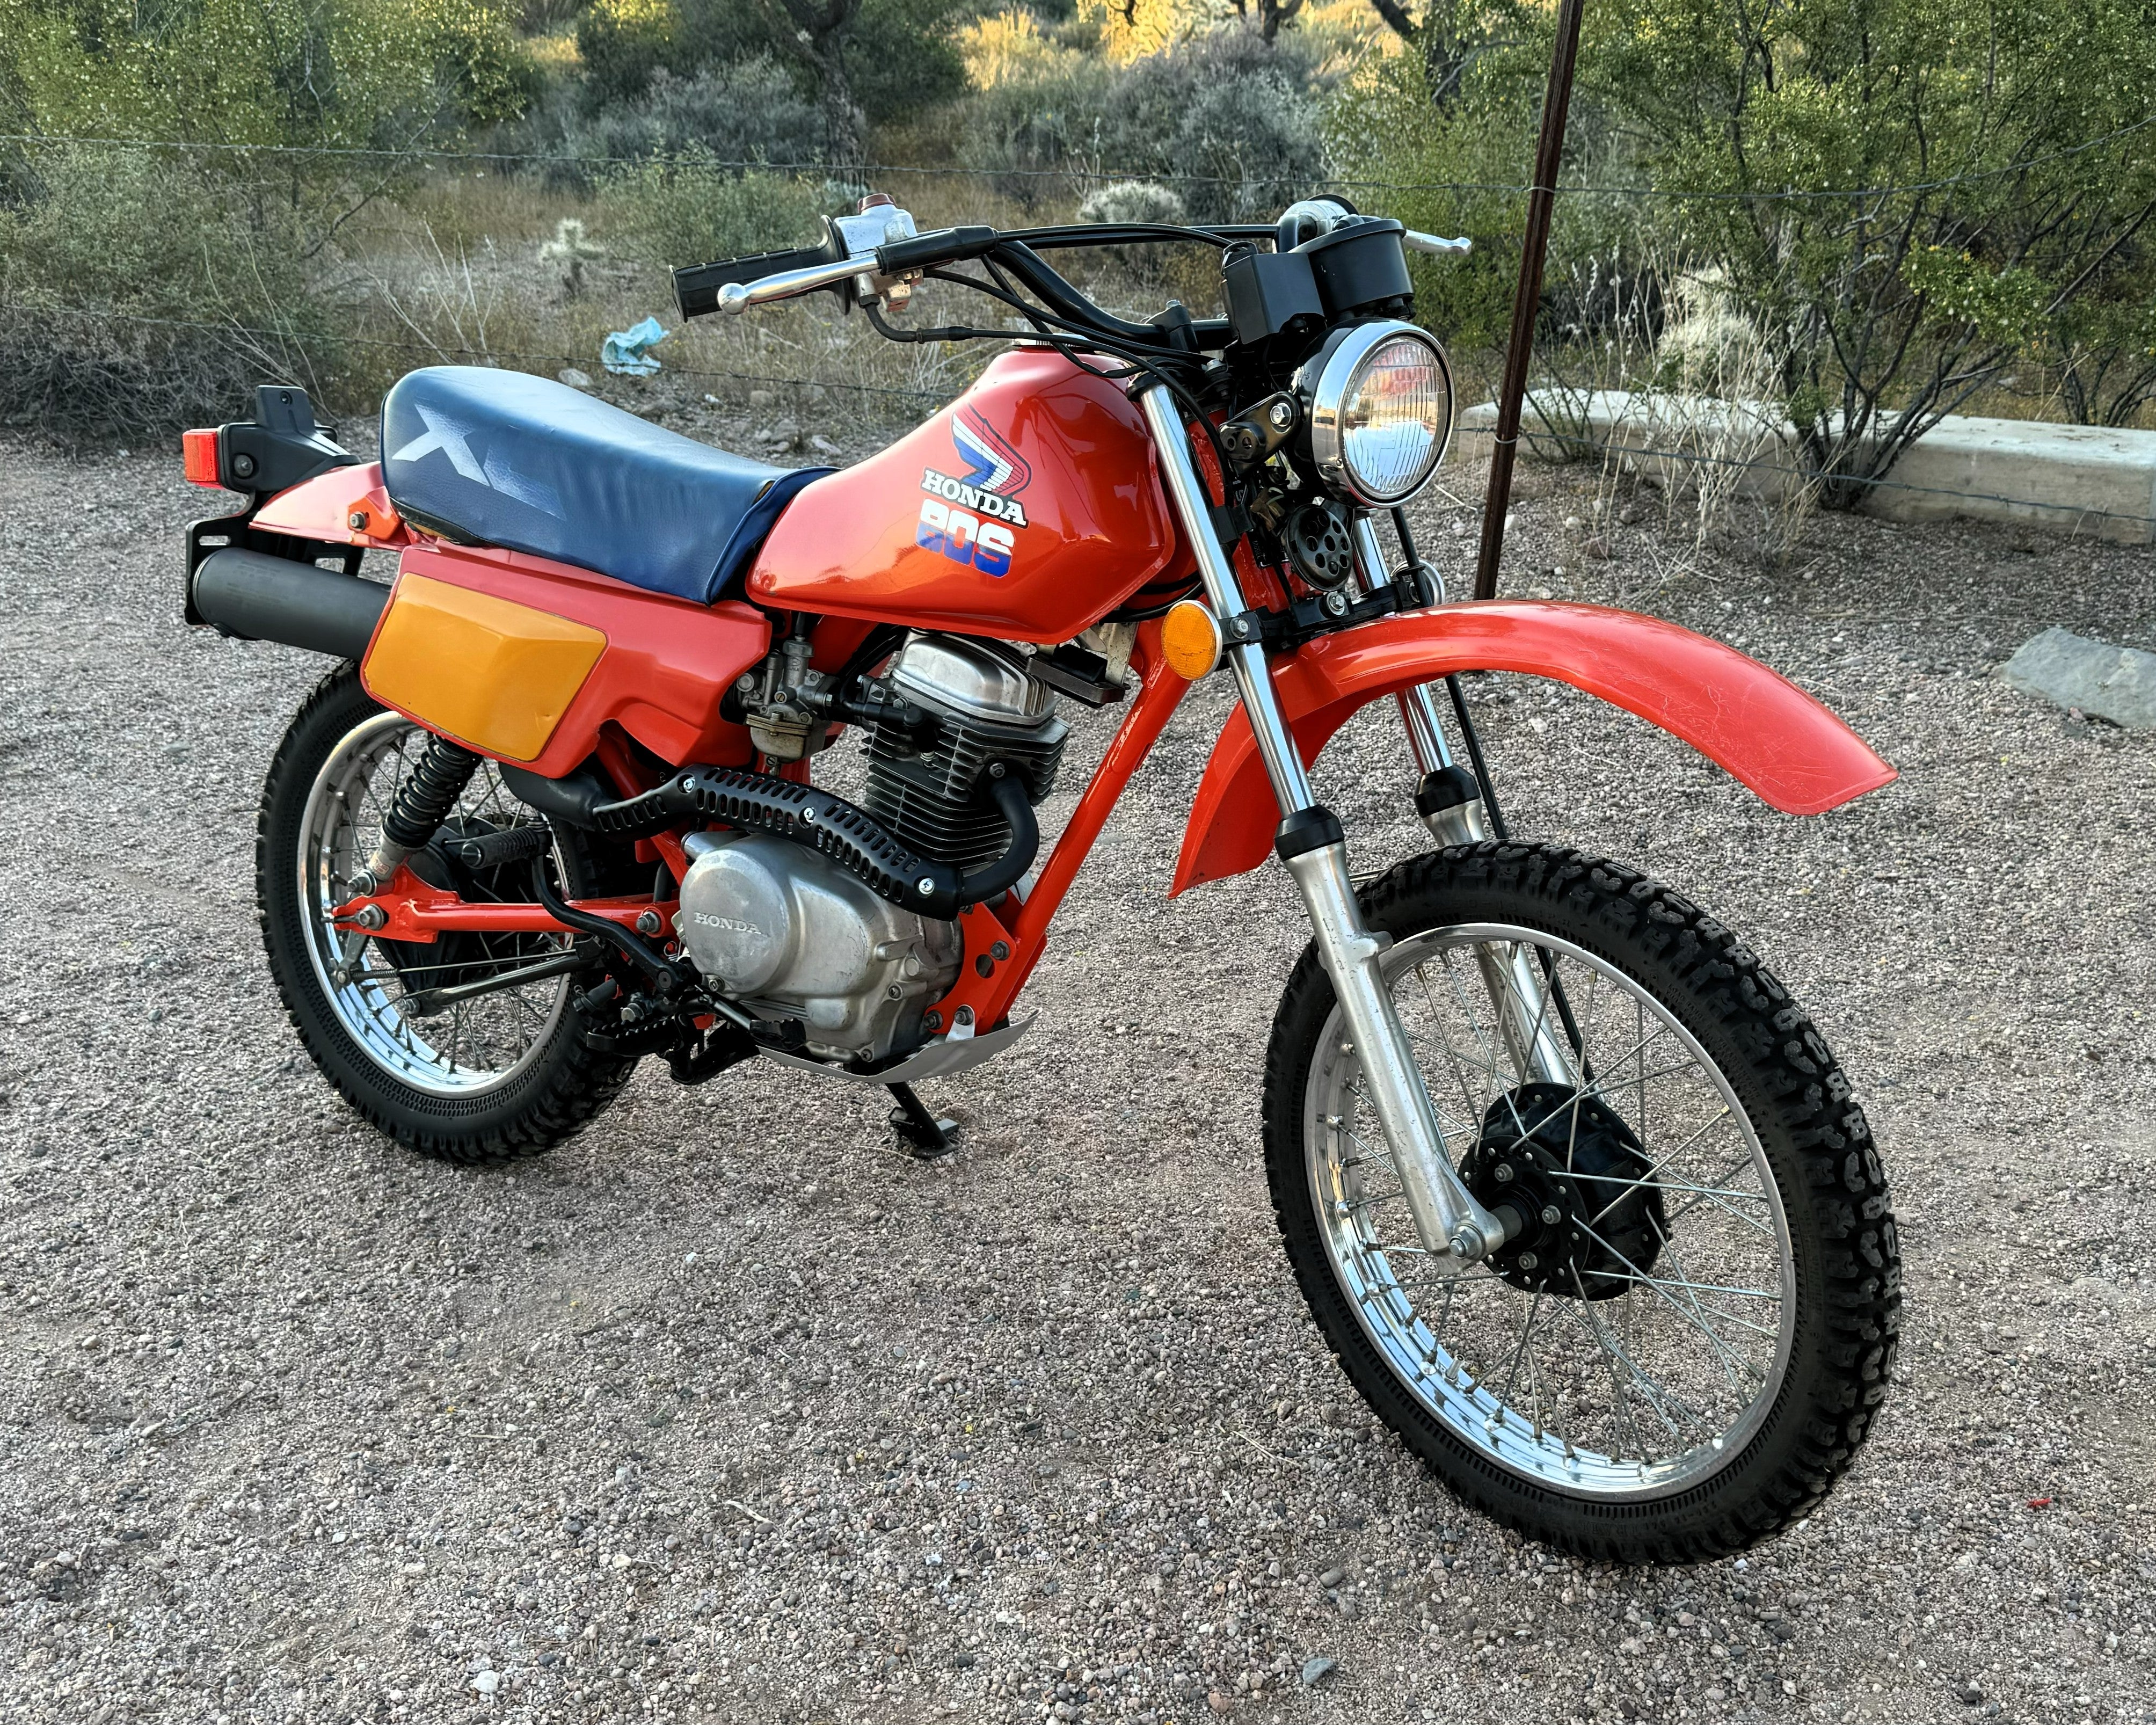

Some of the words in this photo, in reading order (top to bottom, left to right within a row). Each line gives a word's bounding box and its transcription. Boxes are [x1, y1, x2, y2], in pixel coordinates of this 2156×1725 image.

[921, 469, 1027, 527] HONDA
[916, 498, 1016, 578] 80S
[694, 912, 762, 935] HONDA
